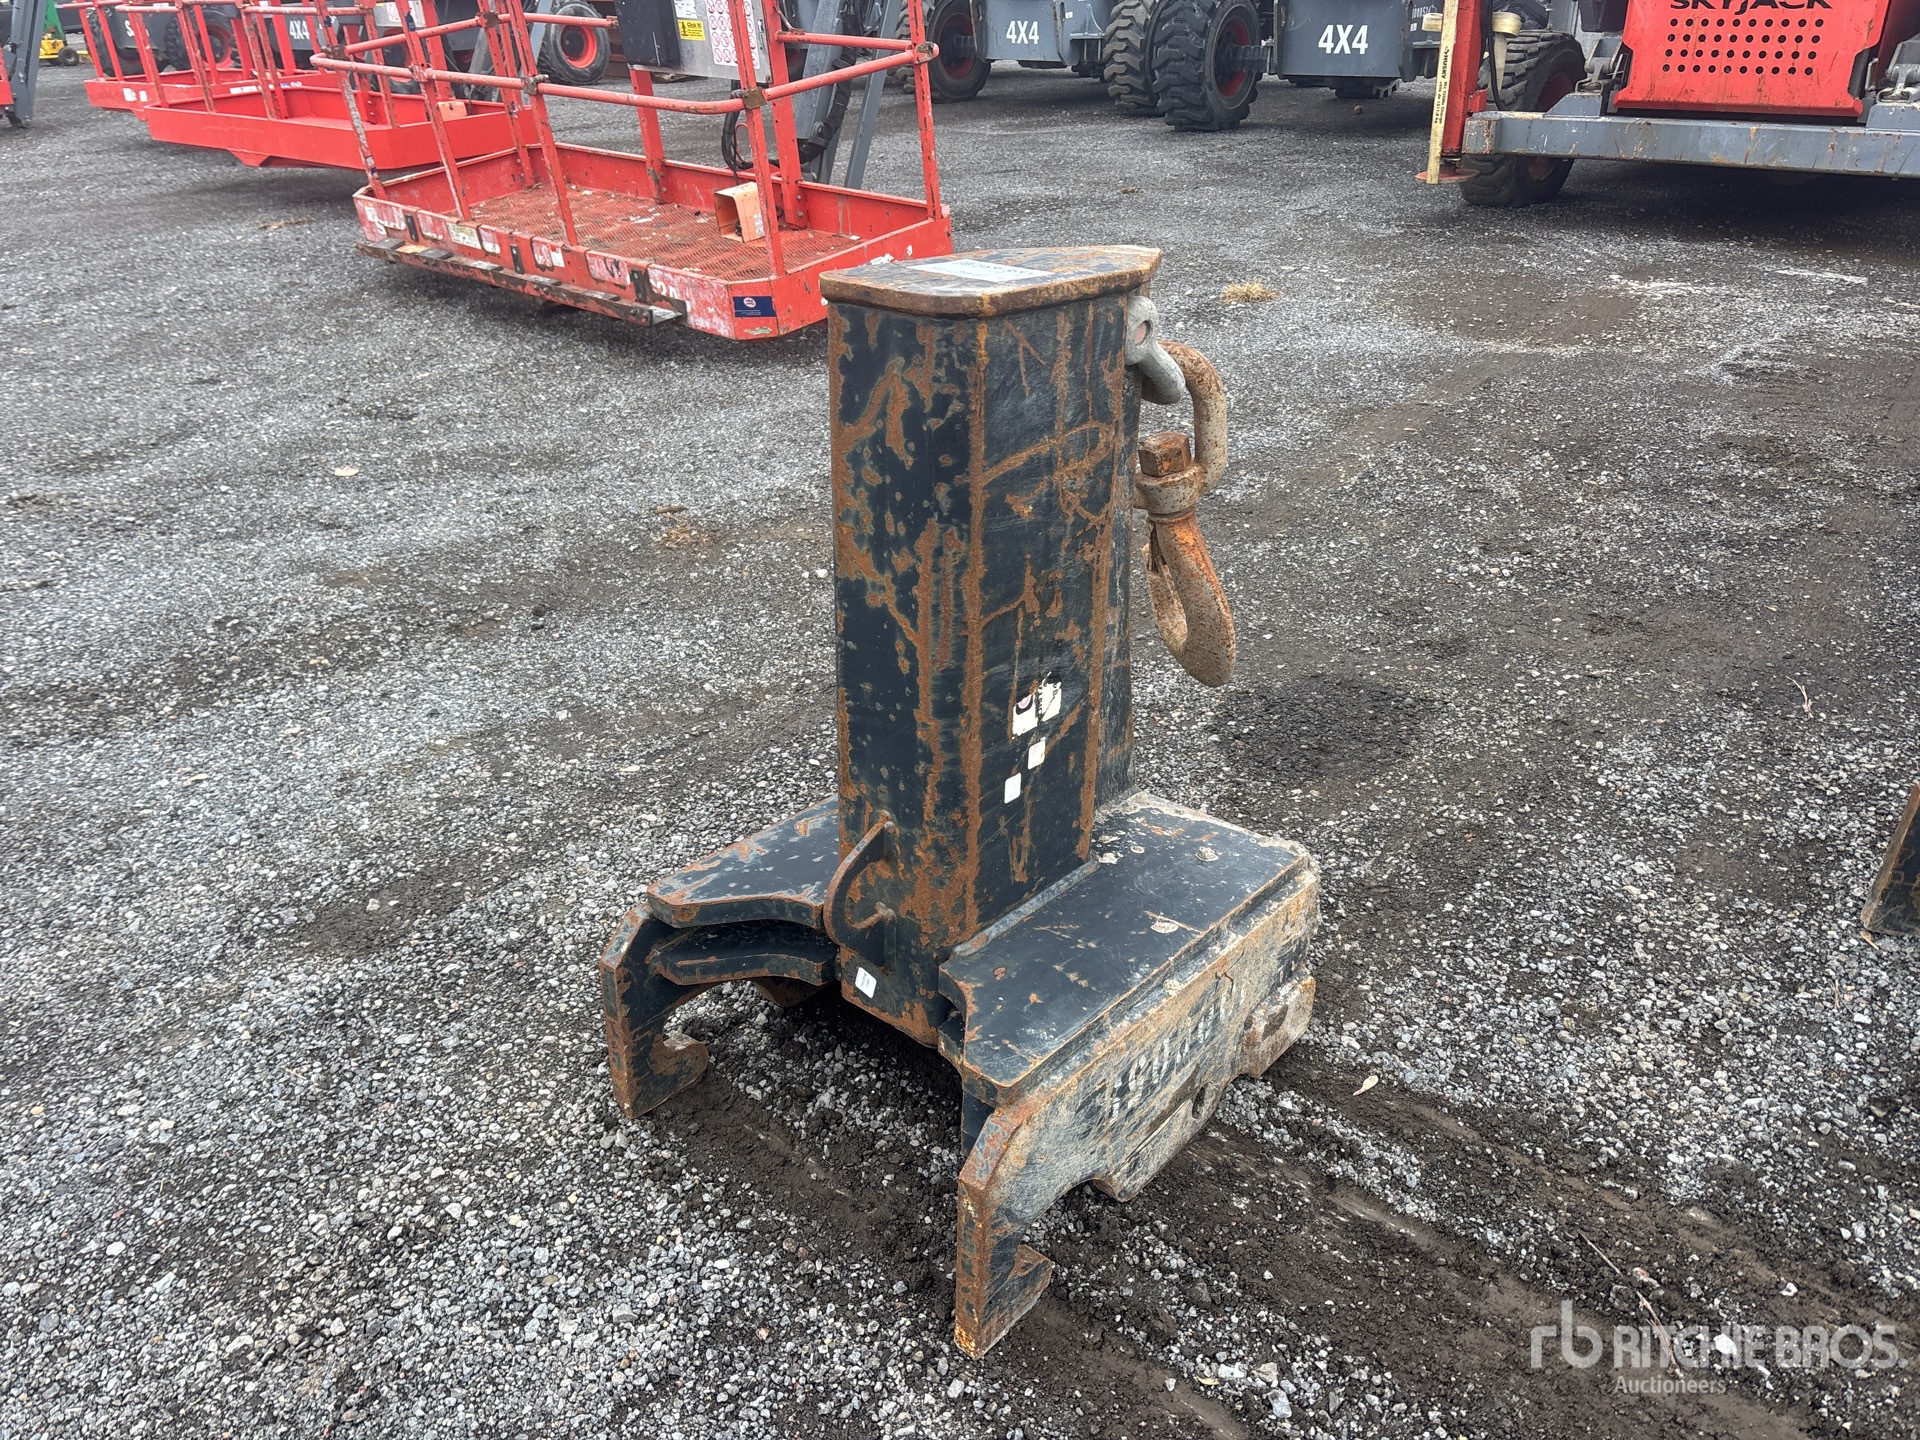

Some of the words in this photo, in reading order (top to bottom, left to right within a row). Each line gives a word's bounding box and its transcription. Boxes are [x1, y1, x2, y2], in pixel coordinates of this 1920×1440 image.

[289, 20, 310, 39] 4X4
[1006, 21, 1039, 44] 4X4
[1318, 24, 1368, 54] 4X4
